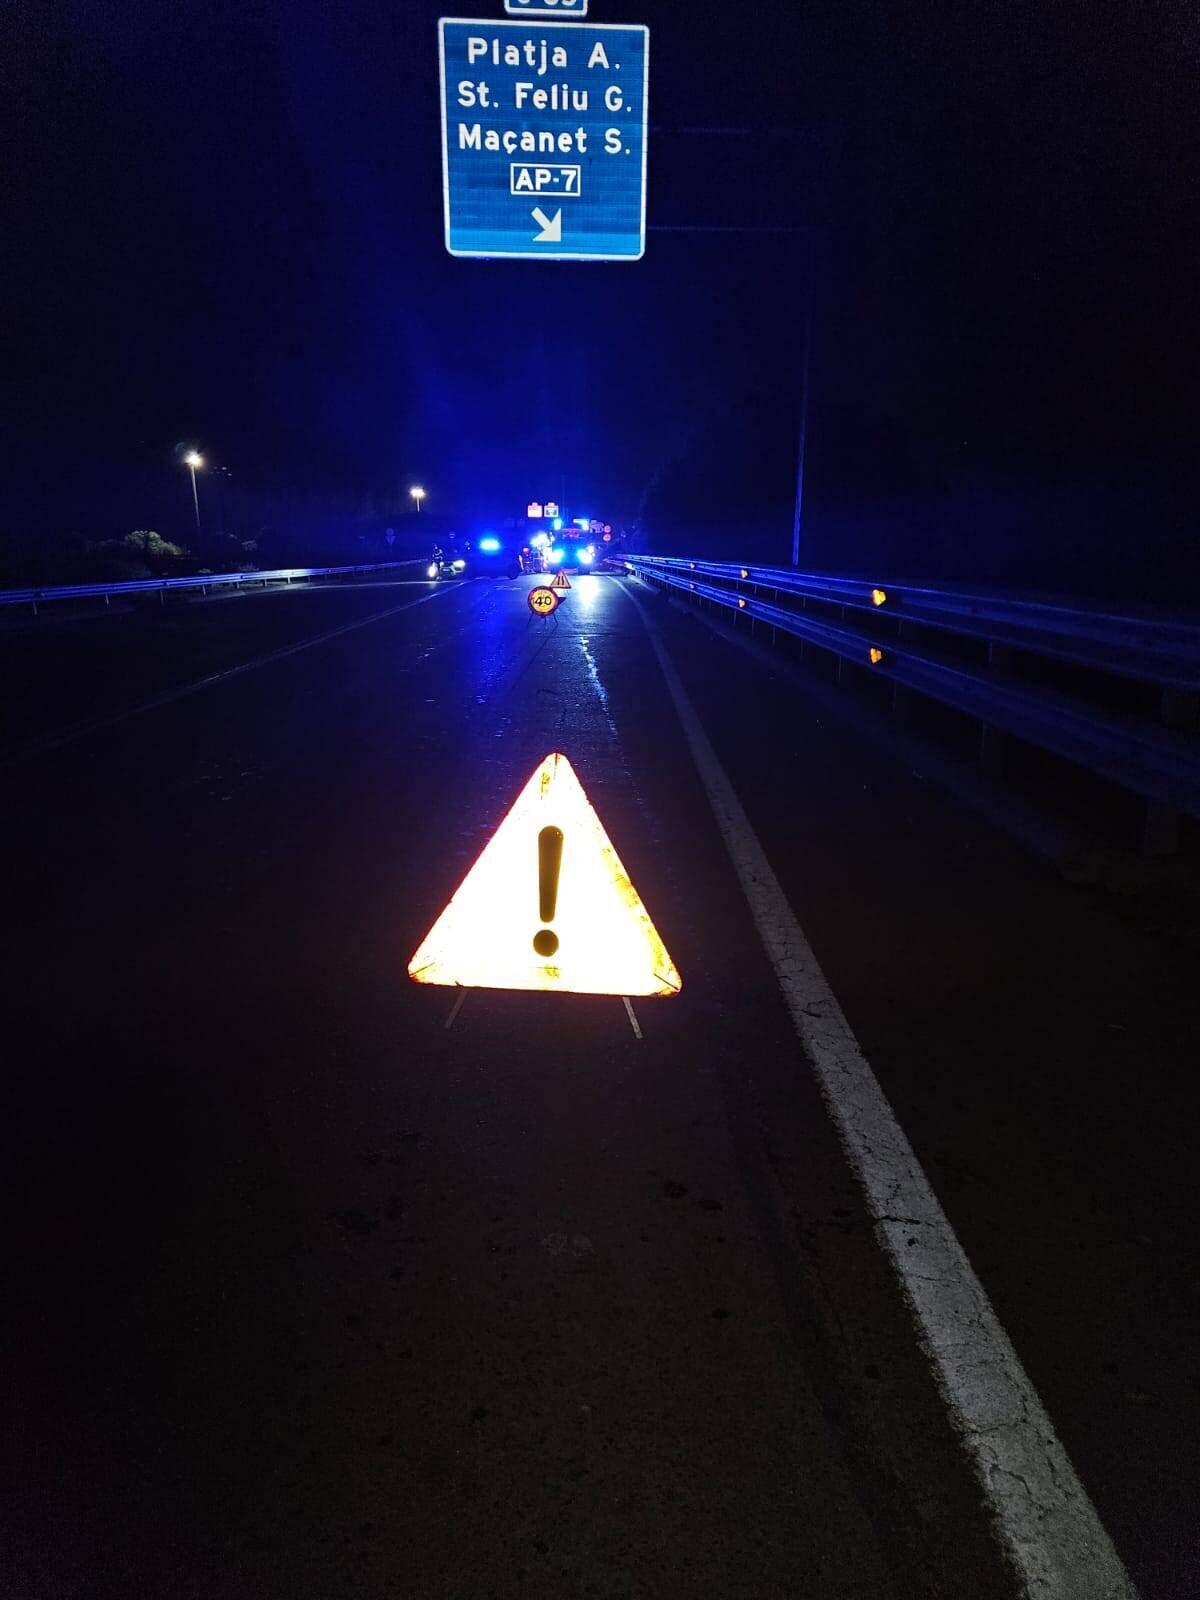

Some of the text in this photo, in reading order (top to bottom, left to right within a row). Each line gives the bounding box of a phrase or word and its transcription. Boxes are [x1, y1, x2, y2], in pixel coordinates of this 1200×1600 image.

[467, 37, 621, 76] Platja A.
[457, 80, 632, 113] St. Feliu G.
[458, 123, 632, 155] Maçanet S.
[515, 168, 577, 192] AP-7
[534, 596, 552, 606] 40
